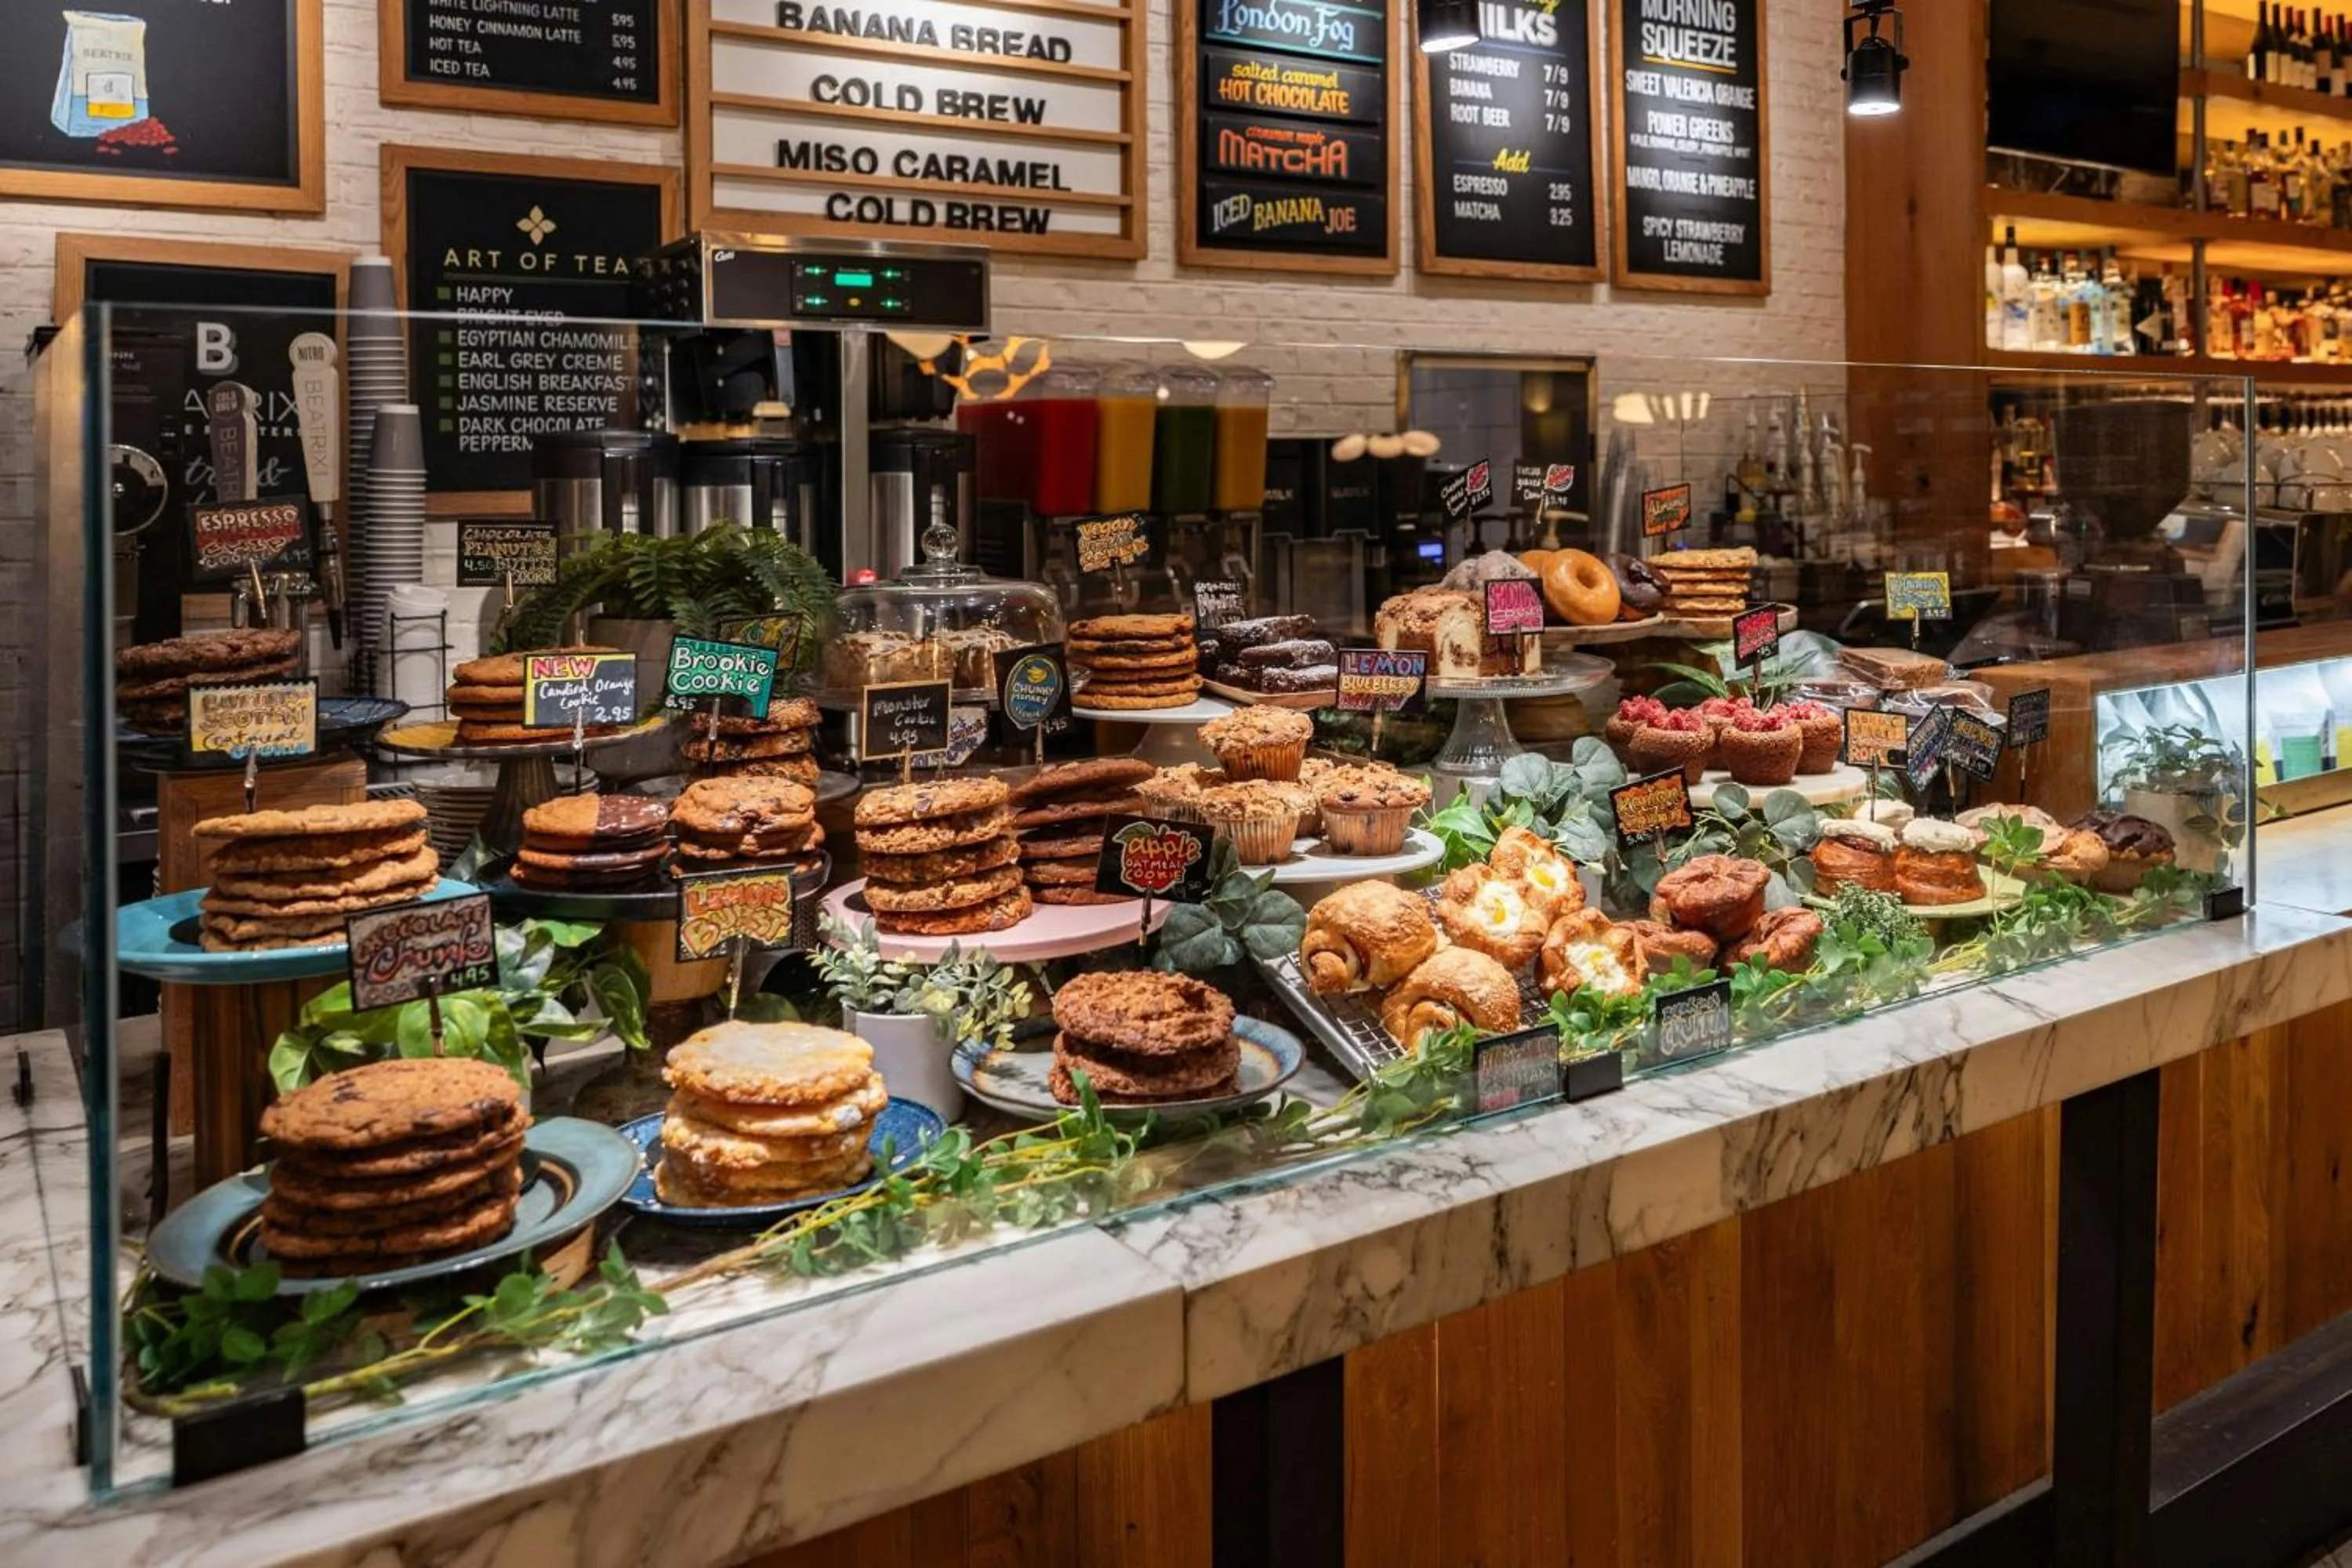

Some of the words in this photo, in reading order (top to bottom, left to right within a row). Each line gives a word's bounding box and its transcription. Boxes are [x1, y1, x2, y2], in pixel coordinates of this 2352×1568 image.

[472, 0, 540, 17] LIGHTNING
[543, 7, 580, 22] LATTE
[1642, 0, 1737, 31] MORNING
[429, 15, 471, 33] HONEY
[477, 20, 541, 39] CINNAMON
[545, 30, 582, 45] LATTE
[775, 0, 938, 47] BANANA
[952, 24, 1073, 64] BREAD
[1308, 6, 1354, 51] Fog
[429, 37, 452, 51] HOT
[457, 39, 482, 54] TEA
[1642, 23, 1737, 67] SQUEEZE
[430, 59, 460, 74] ICED
[464, 62, 491, 78] TEA
[1232, 62, 1279, 82] salted
[1450, 53, 1520, 77] STRAWBERRY
[1544, 64, 1568, 84] 7/9
[811, 74, 924, 113] COLD
[937, 89, 1046, 125] BREW
[1218, 78, 1253, 103] HOT
[1256, 82, 1350, 114] CHOCOLATE
[1450, 78, 1492, 100] BANANA
[1544, 89, 1569, 109] 7/9
[1626, 69, 1661, 96] SWEET
[1663, 74, 1715, 103] VALENCIA
[1715, 82, 1755, 110] ORANGE
[1450, 103, 1479, 122] ROOT
[1483, 107, 1510, 127] BEER
[1545, 114, 1570, 133] 7/9
[1647, 111, 1687, 137] POWER
[1688, 117, 1734, 143] GREENS
[776, 139, 878, 174] MISO
[893, 149, 1072, 191] CARAMEL
[1219, 129, 1348, 179] MATCHA
[1493, 148, 1530, 173] Add
[1454, 175, 1508, 195] ESPRESSO
[1708, 175, 1755, 199] PINEAPPLE
[826, 193, 936, 227] COLD
[946, 201, 1052, 234] BREW
[1213, 194, 1251, 232] ICED
[1254, 198, 1326, 231] BANANA
[1325, 208, 1357, 233] JOE
[1454, 201, 1501, 220] MATCHA
[1643, 216, 1674, 237] SPICY
[1675, 219, 1745, 244] STRAWBERRY
[444, 249, 502, 268] ART
[520, 252, 557, 270] OF
[575, 255, 630, 274] TEA
[1664, 239, 1724, 266] LEMONADE
[456, 286, 514, 303] HAPPY
[198, 321, 235, 372] B
[458, 330, 535, 347] EGYPTIAN
[458, 353, 506, 369] EARL
[510, 353, 557, 370] GREY
[562, 354, 623, 372] CREME
[458, 374, 532, 390] ENGLISH
[457, 396, 539, 412] JASMINE
[544, 396, 619, 413] RESERVE
[459, 417, 506, 433] DARK
[200, 509, 297, 532] ESPRESSO
[532, 657, 595, 679] NEW
[673, 647, 769, 675] Brookie
[1343, 654, 1425, 674] LEMON
[596, 679, 634, 695] Orange
[672, 672, 760, 693] Cookie
[595, 707, 632, 722] 2.95
[1126, 869, 1181, 880] COOKIE
[1127, 858, 1181, 869] OATMEAL
[688, 881, 787, 916] LEMON
